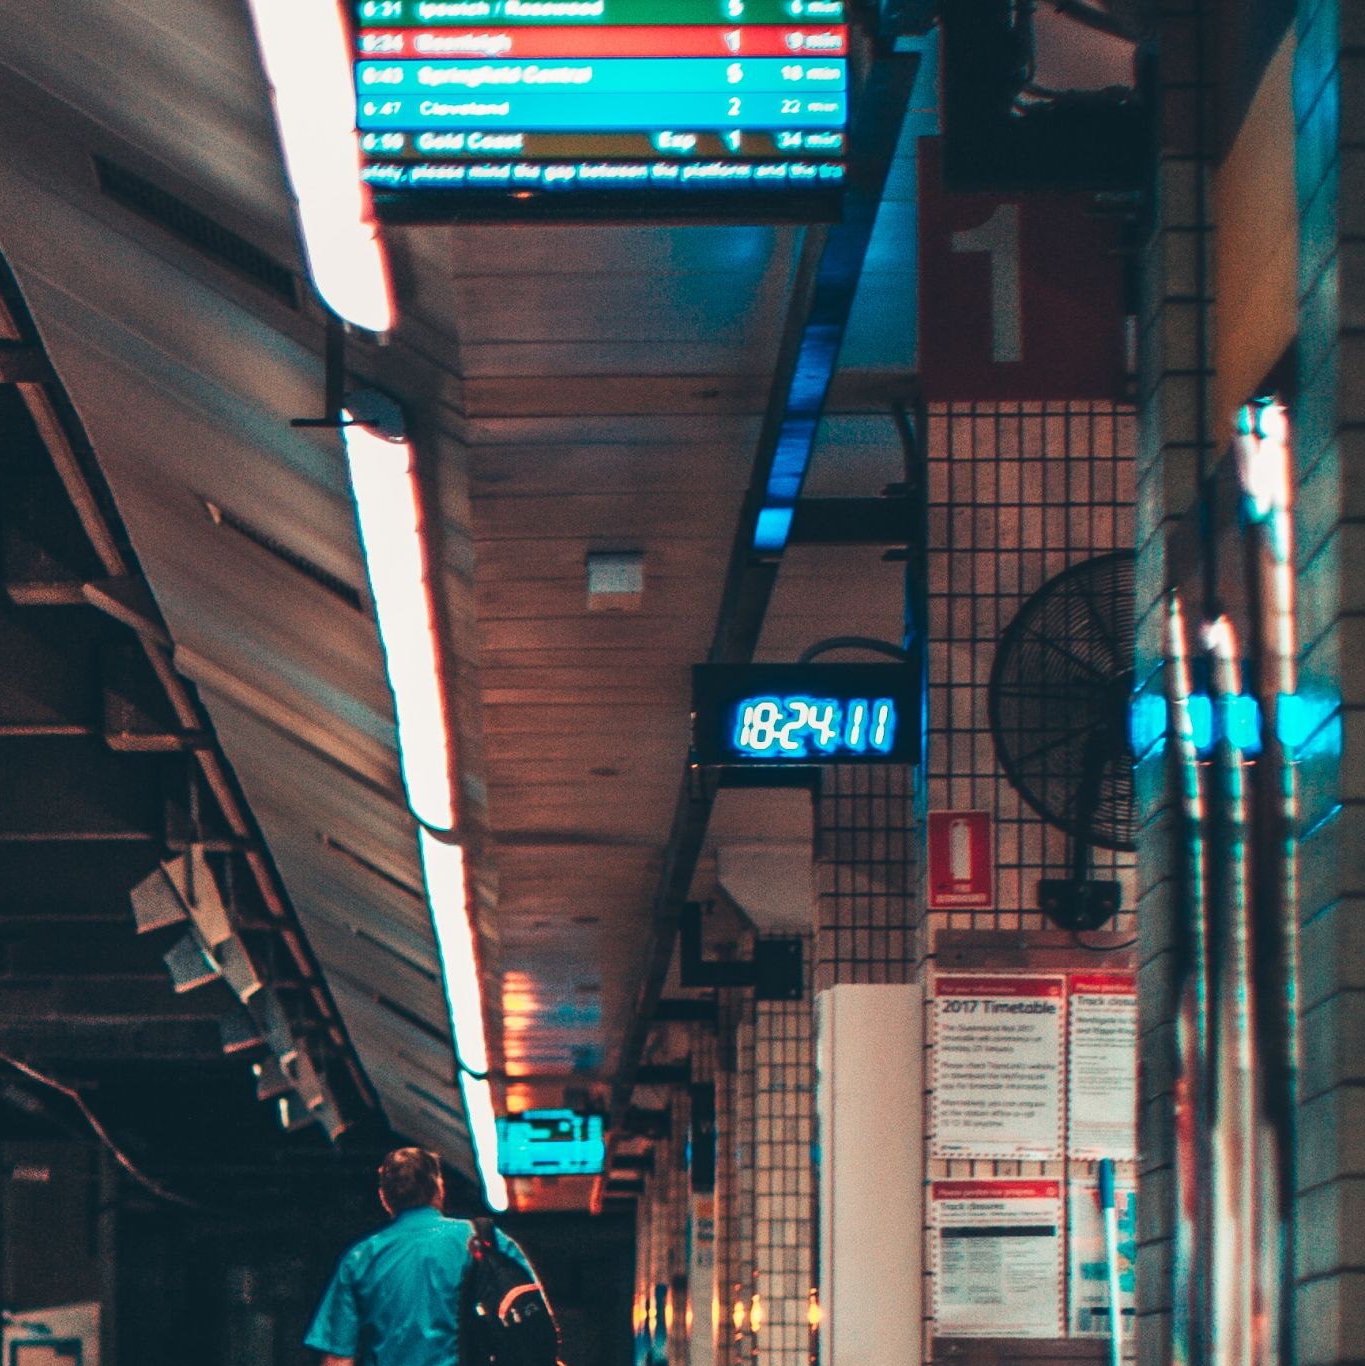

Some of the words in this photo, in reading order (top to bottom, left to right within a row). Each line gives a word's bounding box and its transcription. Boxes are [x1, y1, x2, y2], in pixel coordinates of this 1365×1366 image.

[419, 100, 510, 116] Cleveland
[727, 96, 741, 116] 2
[780, 99, 801, 113] 22
[418, 131, 465, 150] Gold
[466, 131, 524, 150] Coast
[467, 162, 512, 179] mind
[513, 162, 541, 179] the
[542, 164, 576, 183] gap
[651, 162, 679, 179] the
[680, 161, 752, 182] platform
[753, 162, 788, 179] and
[789, 162, 818, 179] the
[952, 203, 1022, 363] 1
[942, 1000, 980, 1013] 2017
[981, 1000, 1057, 1015] Timetable
